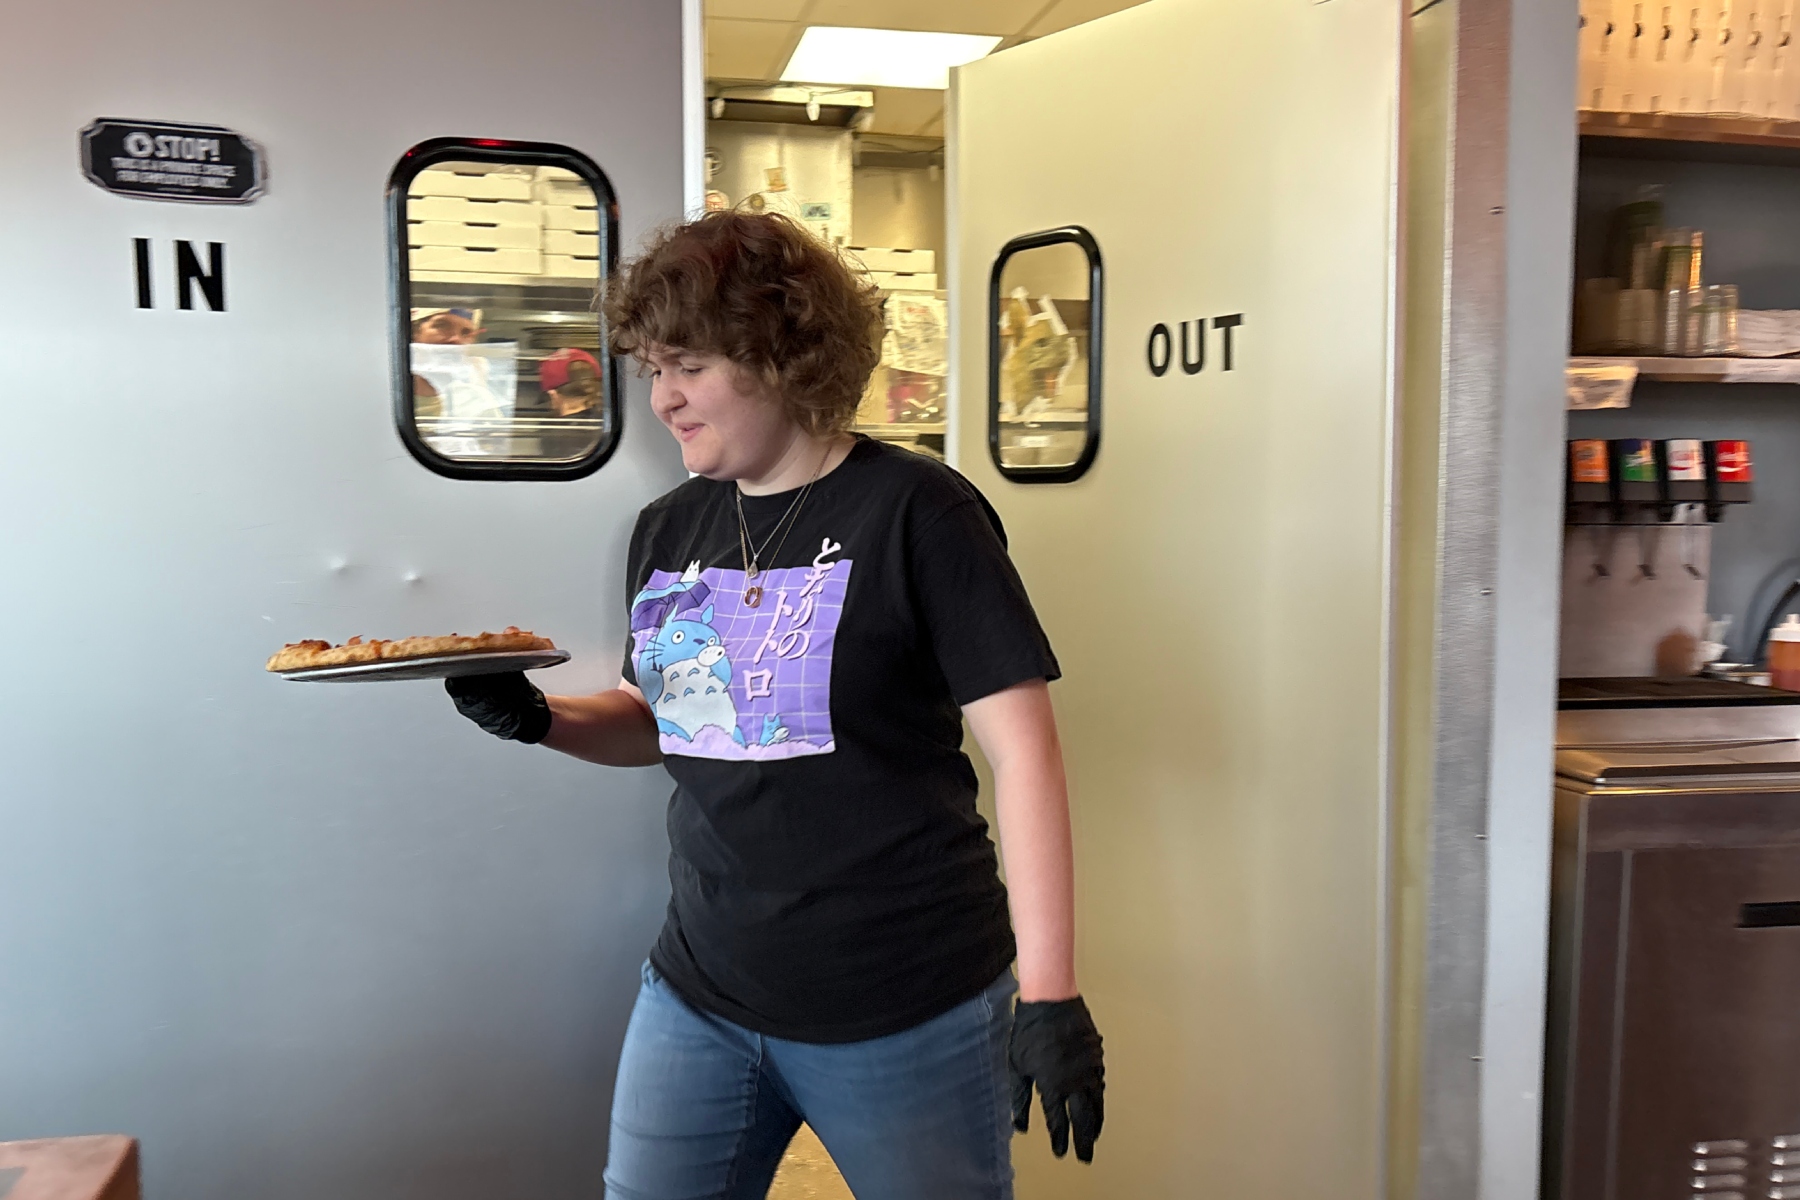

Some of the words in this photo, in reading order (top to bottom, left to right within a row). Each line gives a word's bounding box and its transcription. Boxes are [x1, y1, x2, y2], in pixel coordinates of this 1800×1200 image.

[155, 134, 220, 162] STOP!
[133, 238, 228, 312] IN
[1147, 313, 1245, 377] OUT
[777, 537, 841, 660] となりの
[743, 591, 793, 702] トトロ
